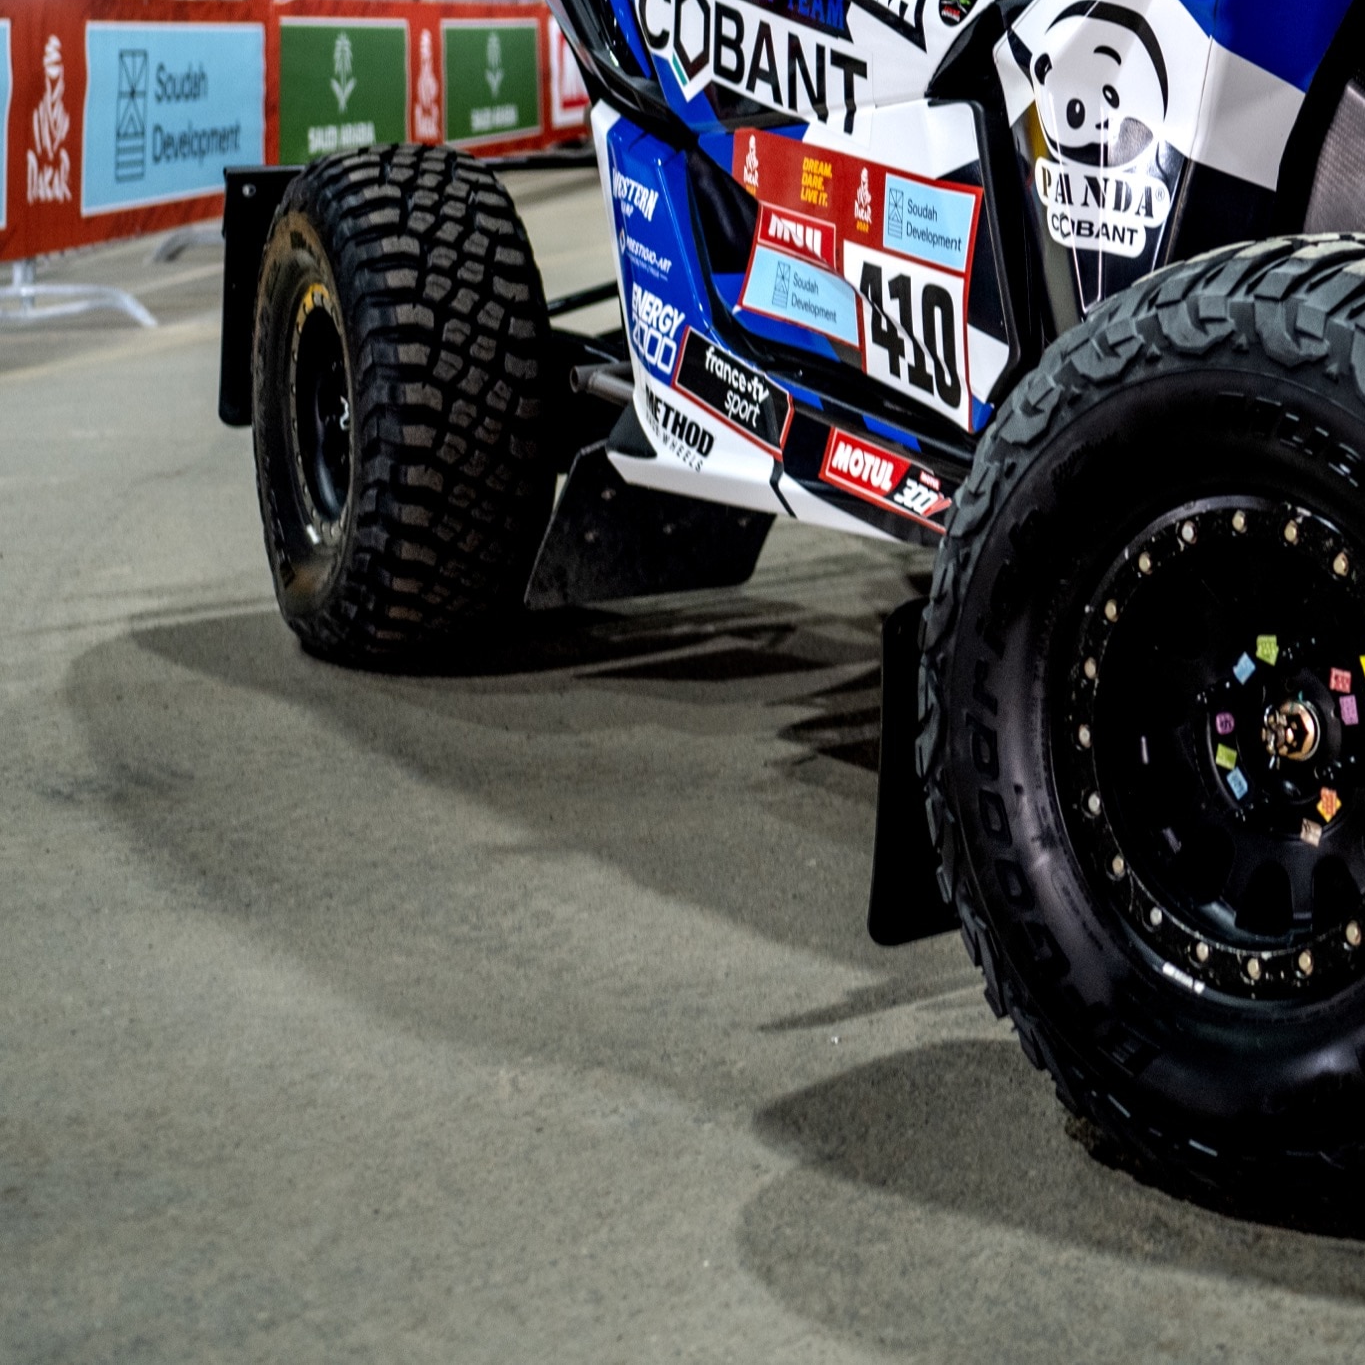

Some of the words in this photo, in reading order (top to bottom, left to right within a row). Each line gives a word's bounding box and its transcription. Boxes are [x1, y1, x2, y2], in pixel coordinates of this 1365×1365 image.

[152, 123, 241, 169] Development
[801, 172, 825, 191] DARE.
[802, 156, 832, 178] DREAM.
[612, 167, 659, 222] WESTERN
[800, 188, 818, 205] LIVE
[907, 199, 939, 223] Soudah
[905, 222, 962, 253] Development
[1051, 212, 1138, 246] COBANT
[792, 271, 820, 296] Soudah
[632, 282, 686, 339] ENERGY
[791, 294, 837, 322] Development
[860, 261, 962, 411] 410
[645, 383, 715, 459] METHOD
[724, 390, 760, 428] sport
[661, 433, 704, 473] WHEELS
[831, 440, 894, 493] MOTUL
